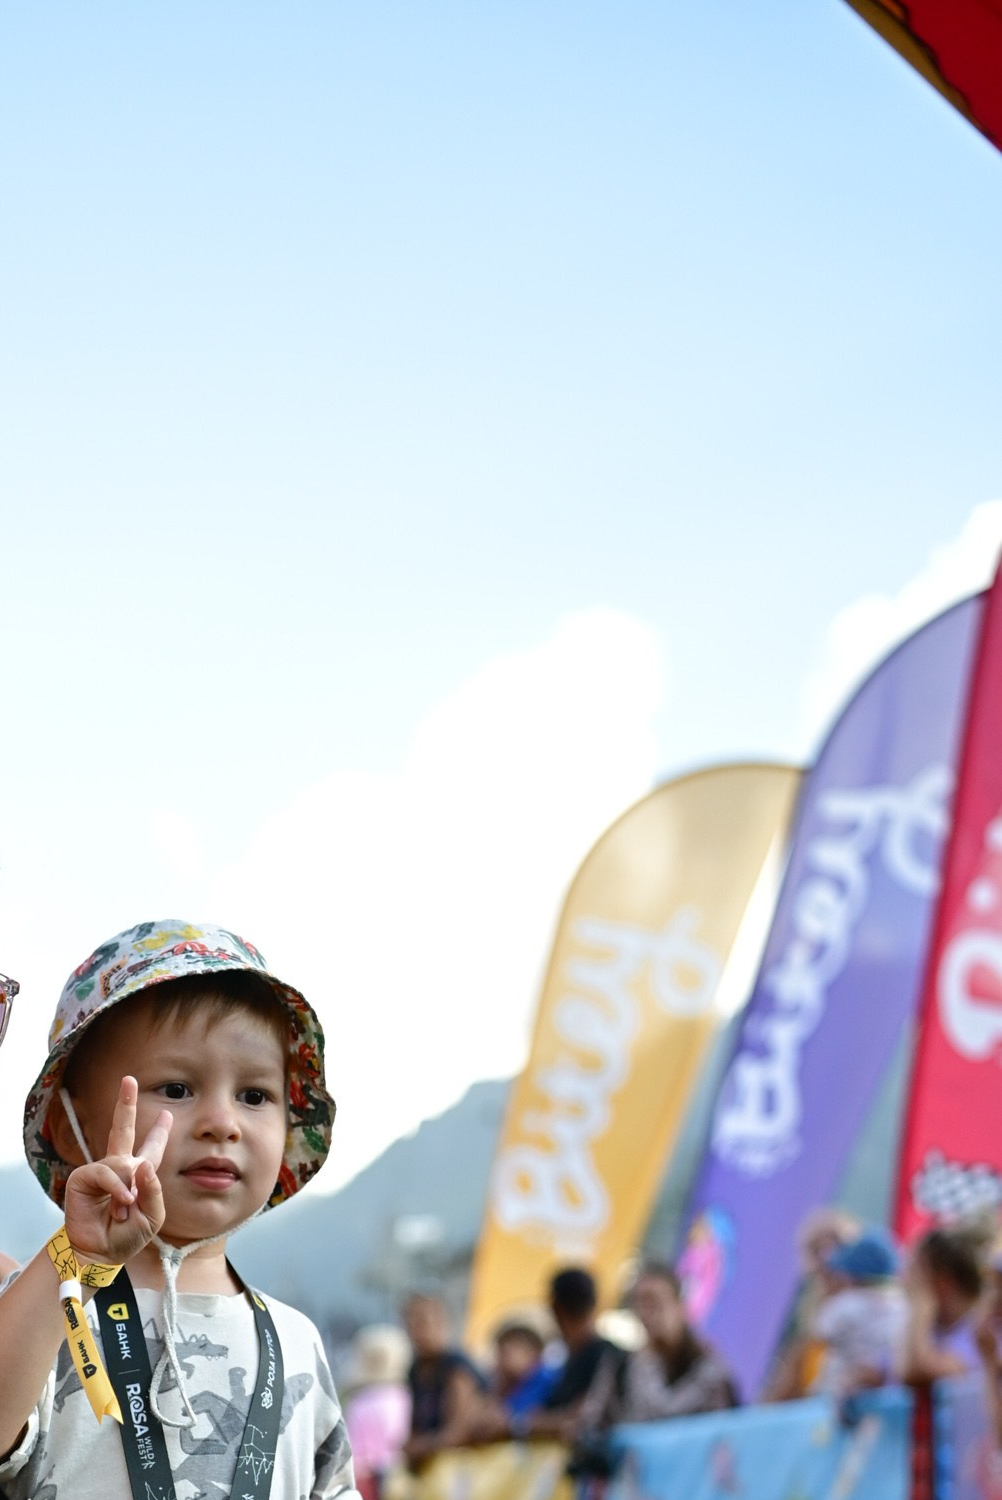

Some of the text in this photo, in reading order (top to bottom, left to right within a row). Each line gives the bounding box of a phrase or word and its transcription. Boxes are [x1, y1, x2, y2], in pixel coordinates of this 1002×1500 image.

[77, 1340, 90, 1364] БАНК
[116, 1323, 132, 1360] БАНК
[126, 1383, 155, 1460] ROSA WILD
[136, 1438, 147, 1460] FEST
